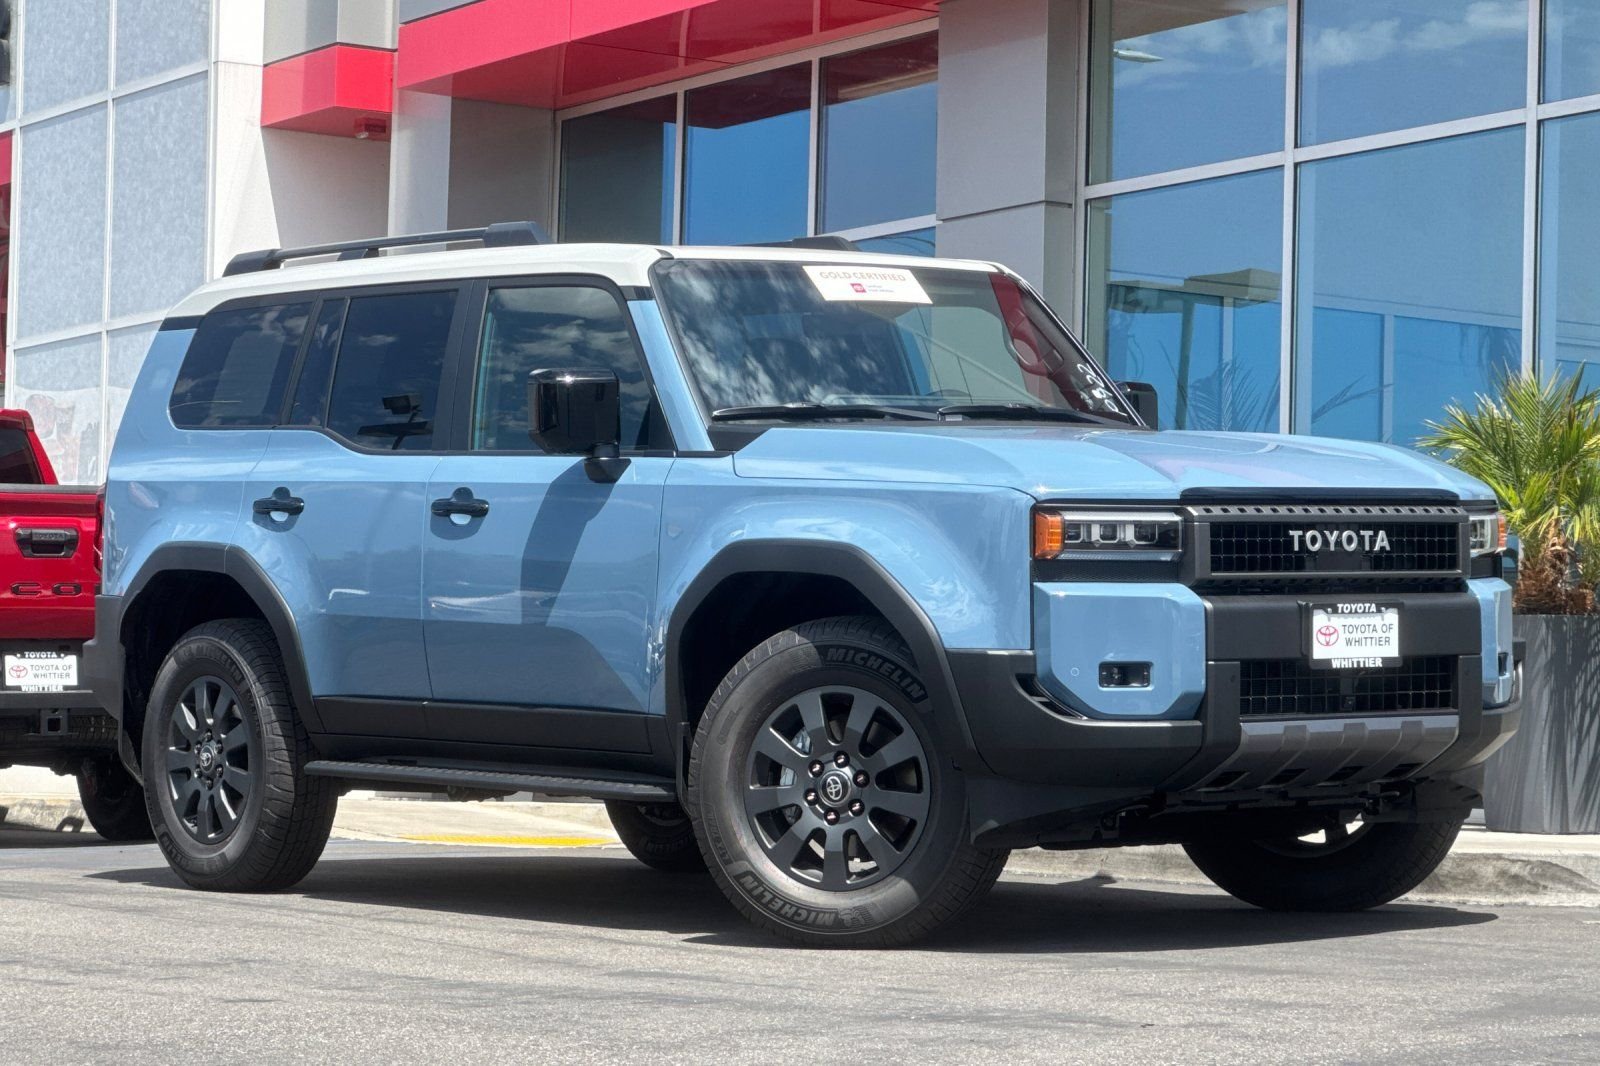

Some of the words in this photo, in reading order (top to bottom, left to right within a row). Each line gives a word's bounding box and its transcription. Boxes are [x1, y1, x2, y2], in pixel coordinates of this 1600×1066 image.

[819, 271, 852, 279] GOLD
[853, 271, 906, 282] CERTIFIED
[1288, 529, 1391, 552] TOYOTA
[1337, 603, 1377, 613] TOYOTA
[1341, 623, 1378, 635] TOYOTA
[1380, 623, 1394, 634] OF
[1344, 636, 1391, 647] WHITTIER
[23, 651, 58, 659] TOYOTA
[1331, 657, 1383, 669] WHITTIER
[826, 647, 926, 701] MICHELIN
[21, 685, 64, 693] WHITTIER
[738, 874, 836, 927] MICHELIN
